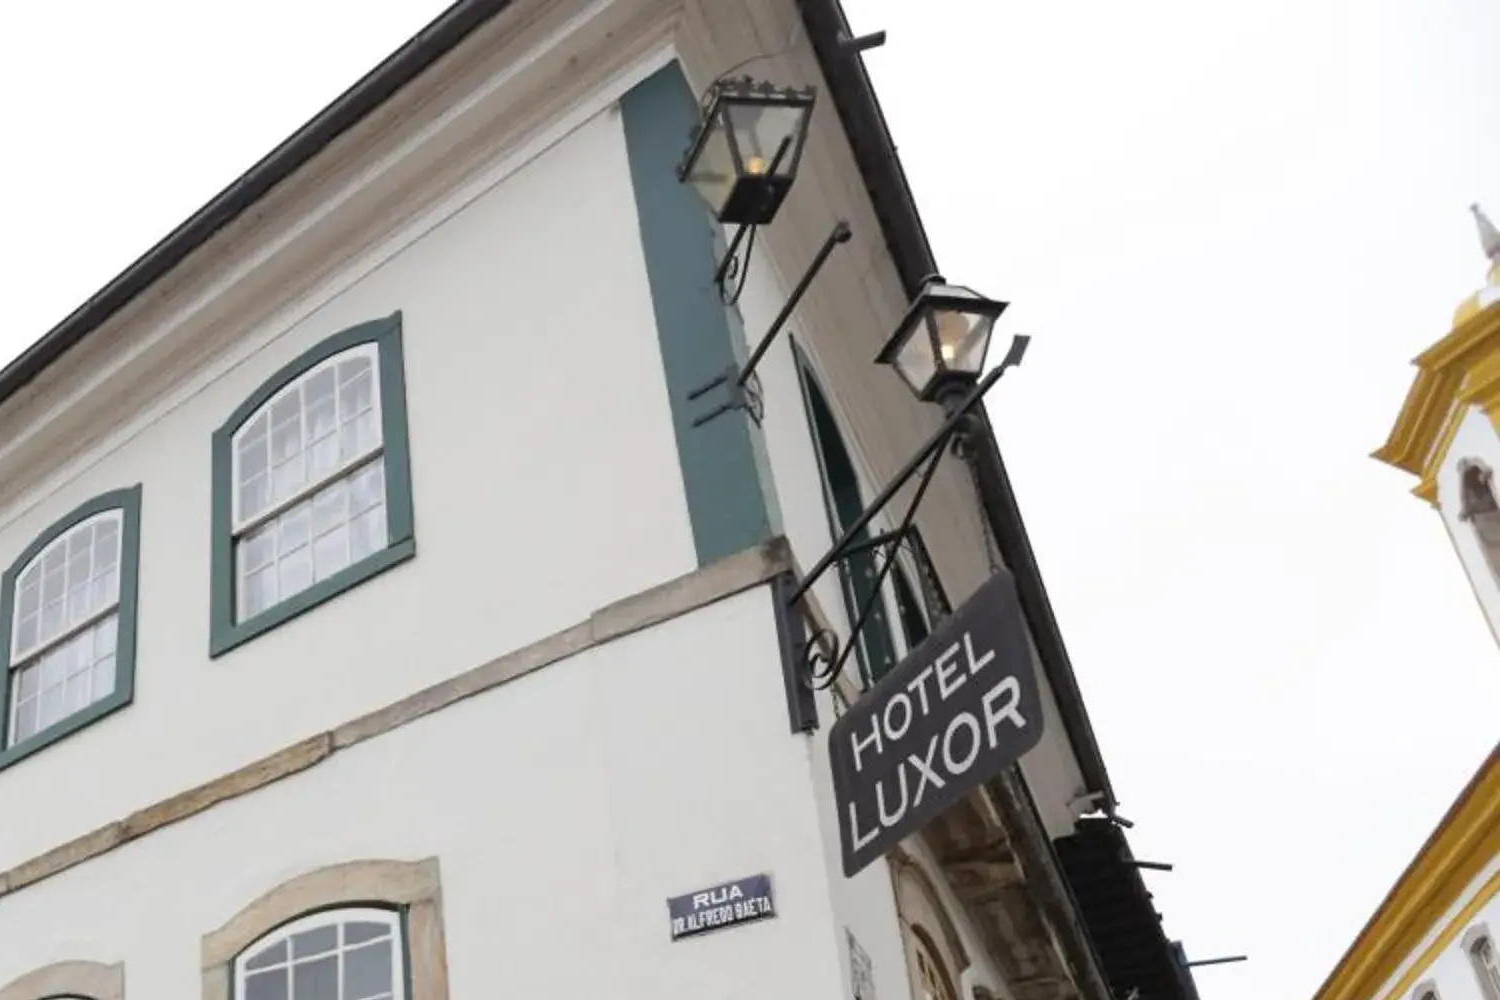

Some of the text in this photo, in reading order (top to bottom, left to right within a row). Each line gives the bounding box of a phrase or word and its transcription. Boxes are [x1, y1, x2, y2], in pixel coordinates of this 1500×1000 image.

[849, 675, 1026, 851] LUXOR
[851, 631, 996, 772] HOTEL
[692, 885, 743, 909] RUA
